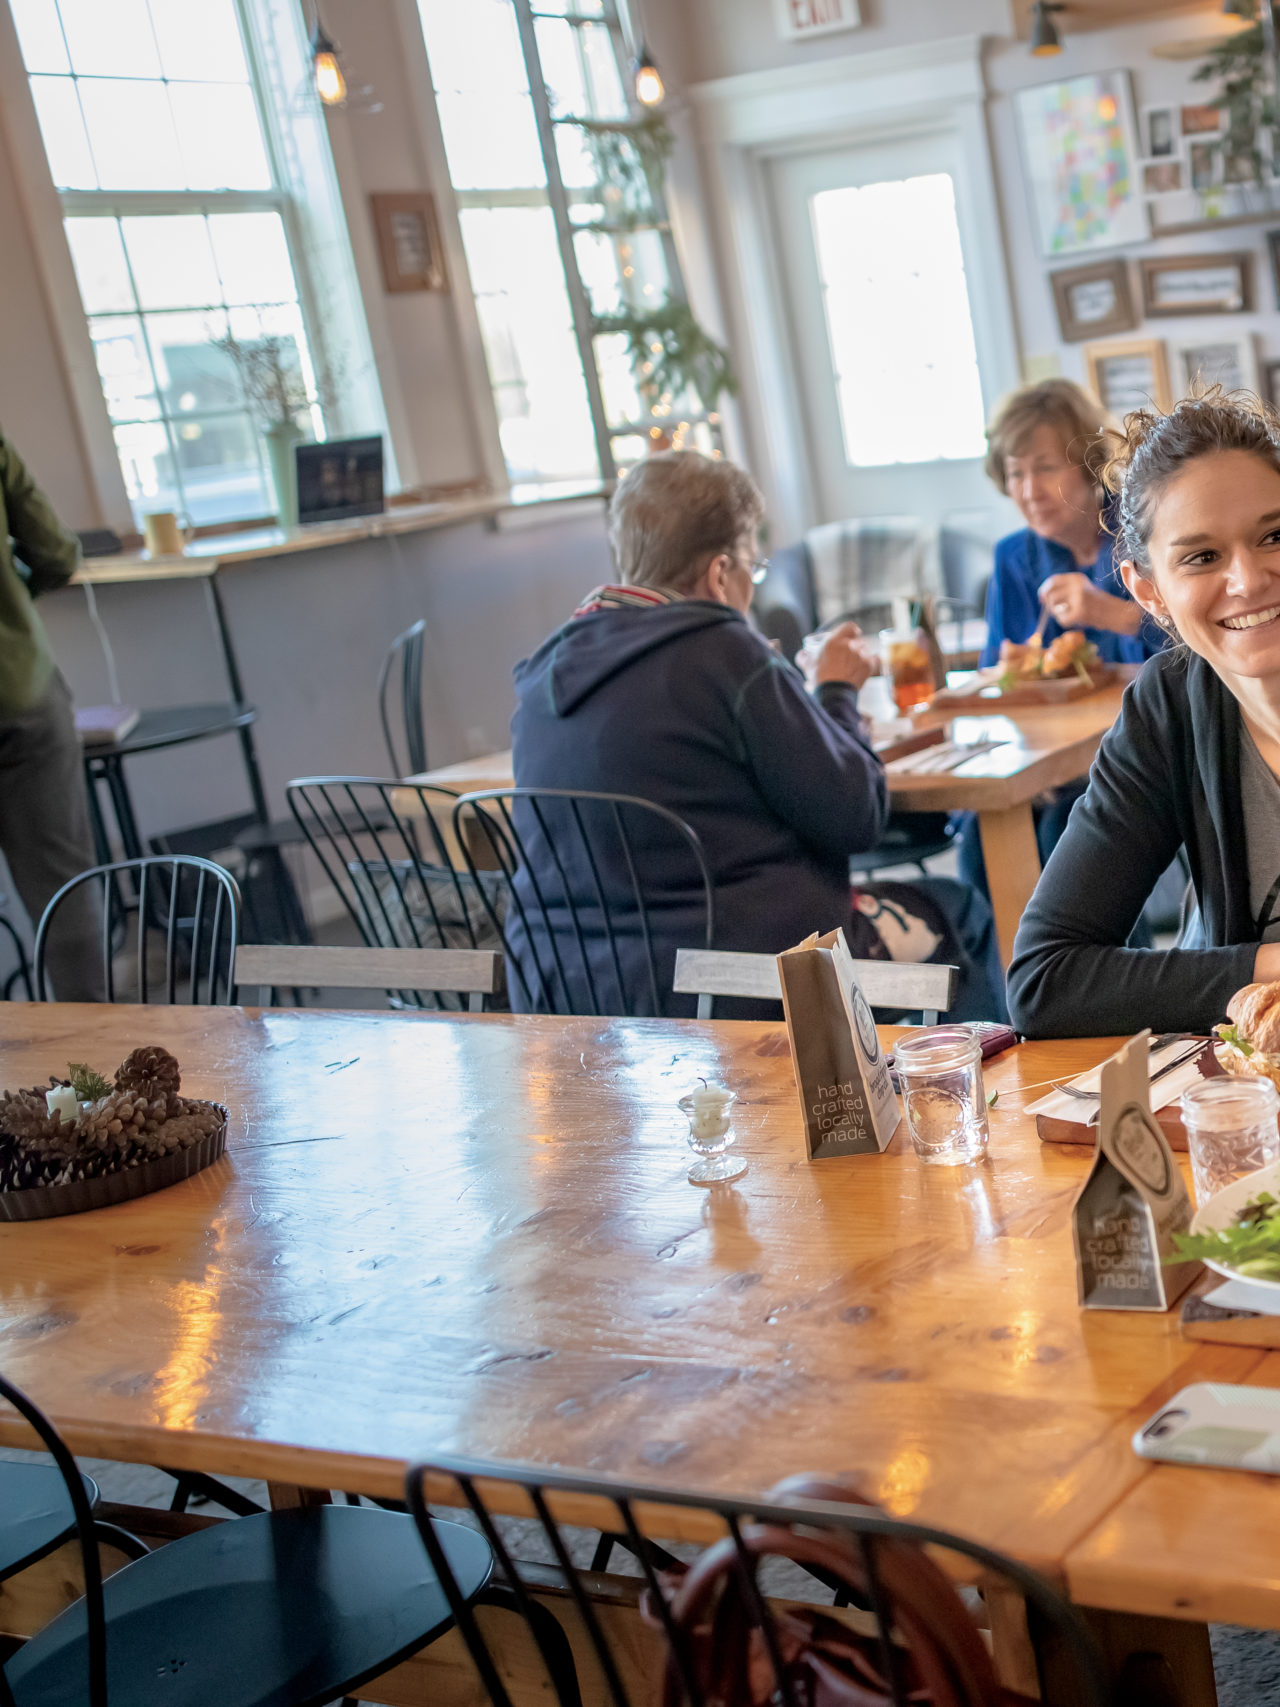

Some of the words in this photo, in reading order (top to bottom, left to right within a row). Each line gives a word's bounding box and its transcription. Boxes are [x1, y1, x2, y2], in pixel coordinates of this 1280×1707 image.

[817, 1080, 853, 1100] hand
[812, 1095, 864, 1116] crafted
[817, 1110, 864, 1130] locally
[821, 1126, 868, 1144] made
[1086, 1233, 1149, 1252] crafted
[1091, 1252, 1149, 1271] locally
[1097, 1271, 1149, 1290] made
